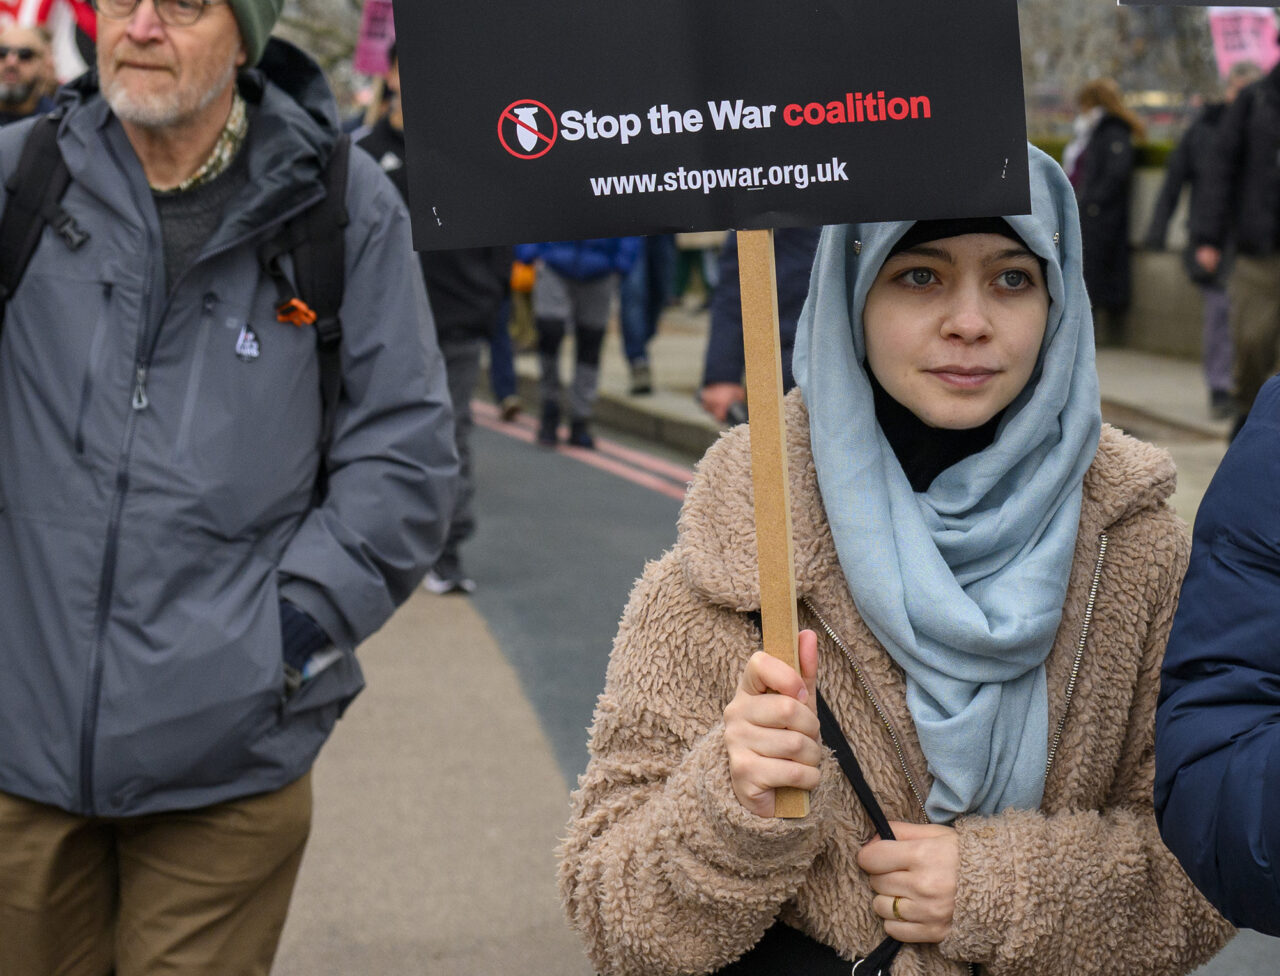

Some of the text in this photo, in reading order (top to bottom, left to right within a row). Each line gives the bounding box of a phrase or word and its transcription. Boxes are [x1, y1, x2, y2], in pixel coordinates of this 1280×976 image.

[560, 91, 932, 144] Stop the War coalition
[590, 157, 849, 195] www.stopwar.org.uk
